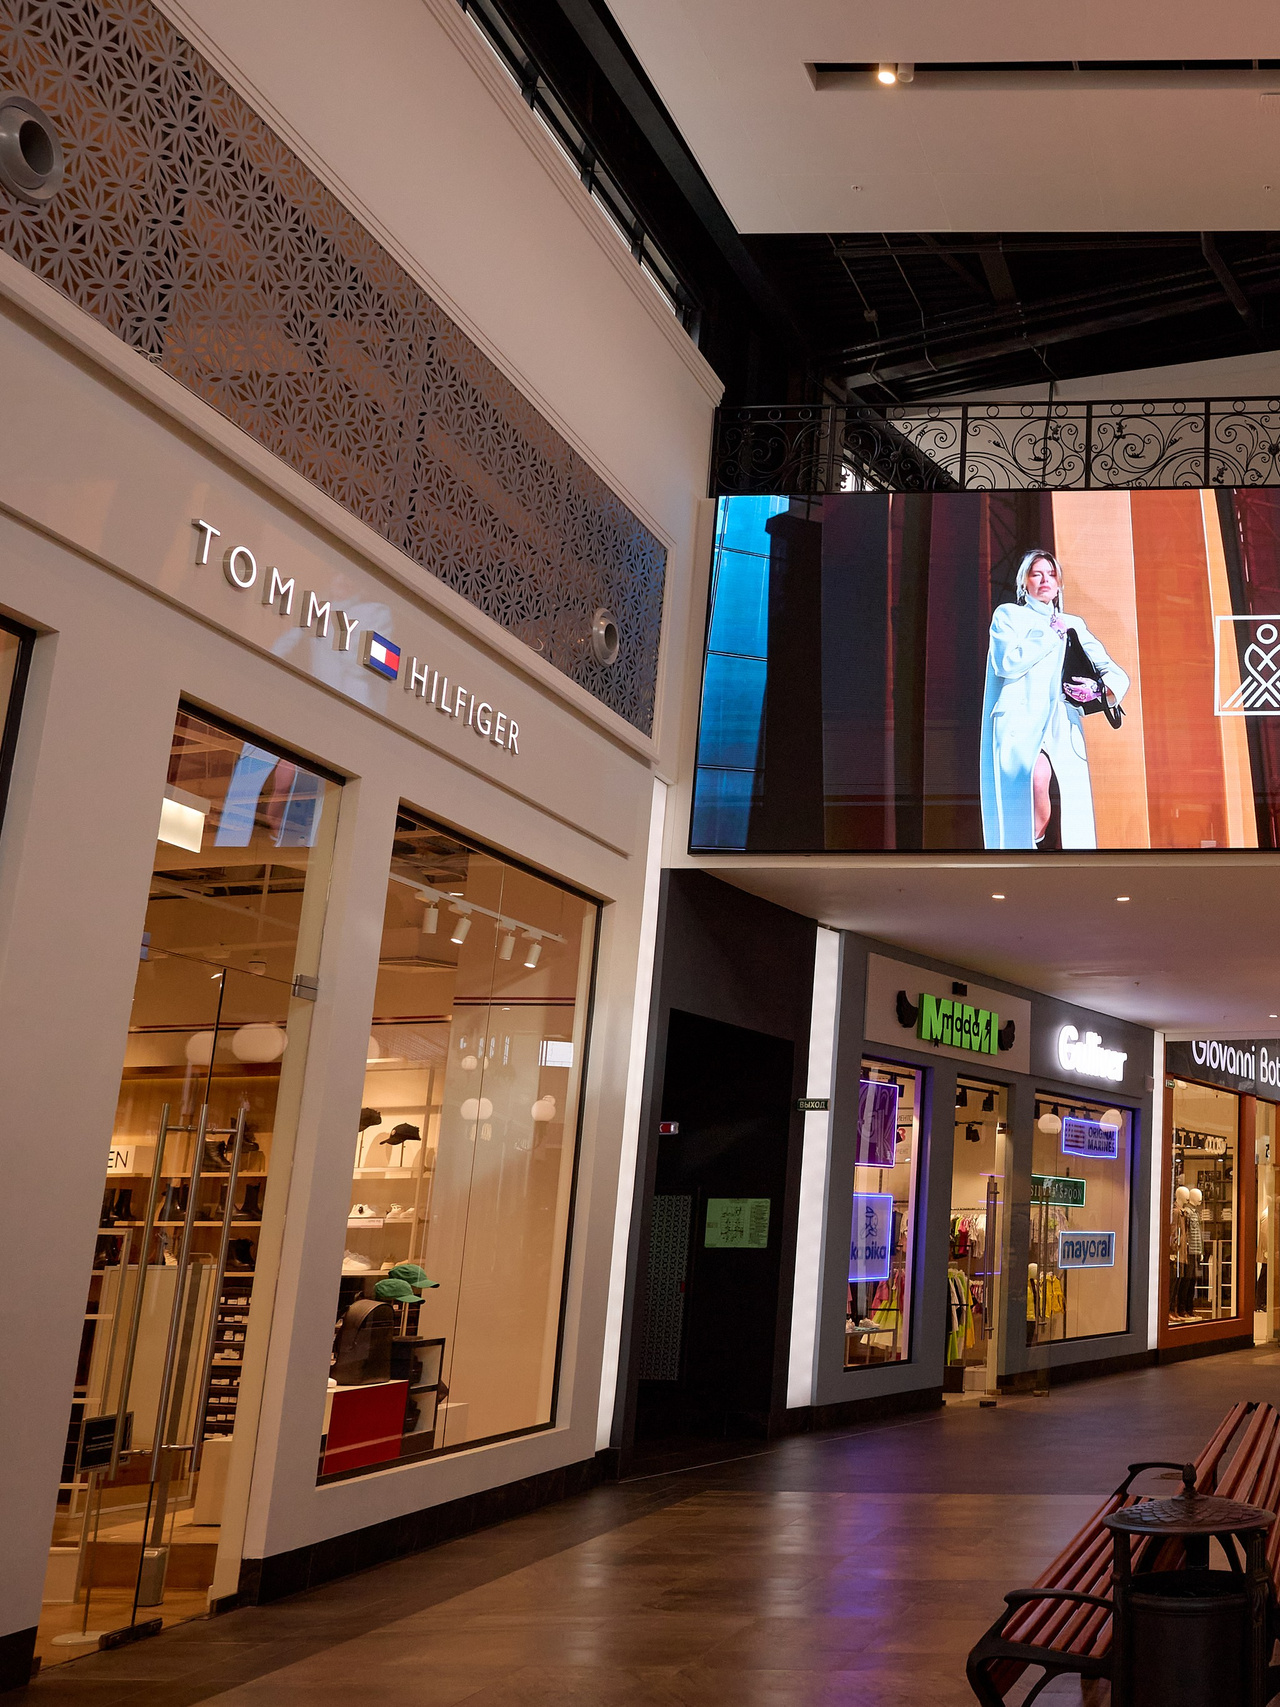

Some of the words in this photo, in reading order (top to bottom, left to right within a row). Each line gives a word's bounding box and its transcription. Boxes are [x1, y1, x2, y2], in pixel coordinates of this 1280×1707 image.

[191, 518, 359, 652] TOMMY
[404, 656, 520, 756] HILFIGER
[1192, 1040, 1255, 1081] Giovanni
[799, 1101, 826, 1109] ВЫХОД
[1088, 1126, 1115, 1141] ORIGINAL
[1087, 1138, 1115, 1153] MARINES
[1063, 1233, 1111, 1264] mayoral
